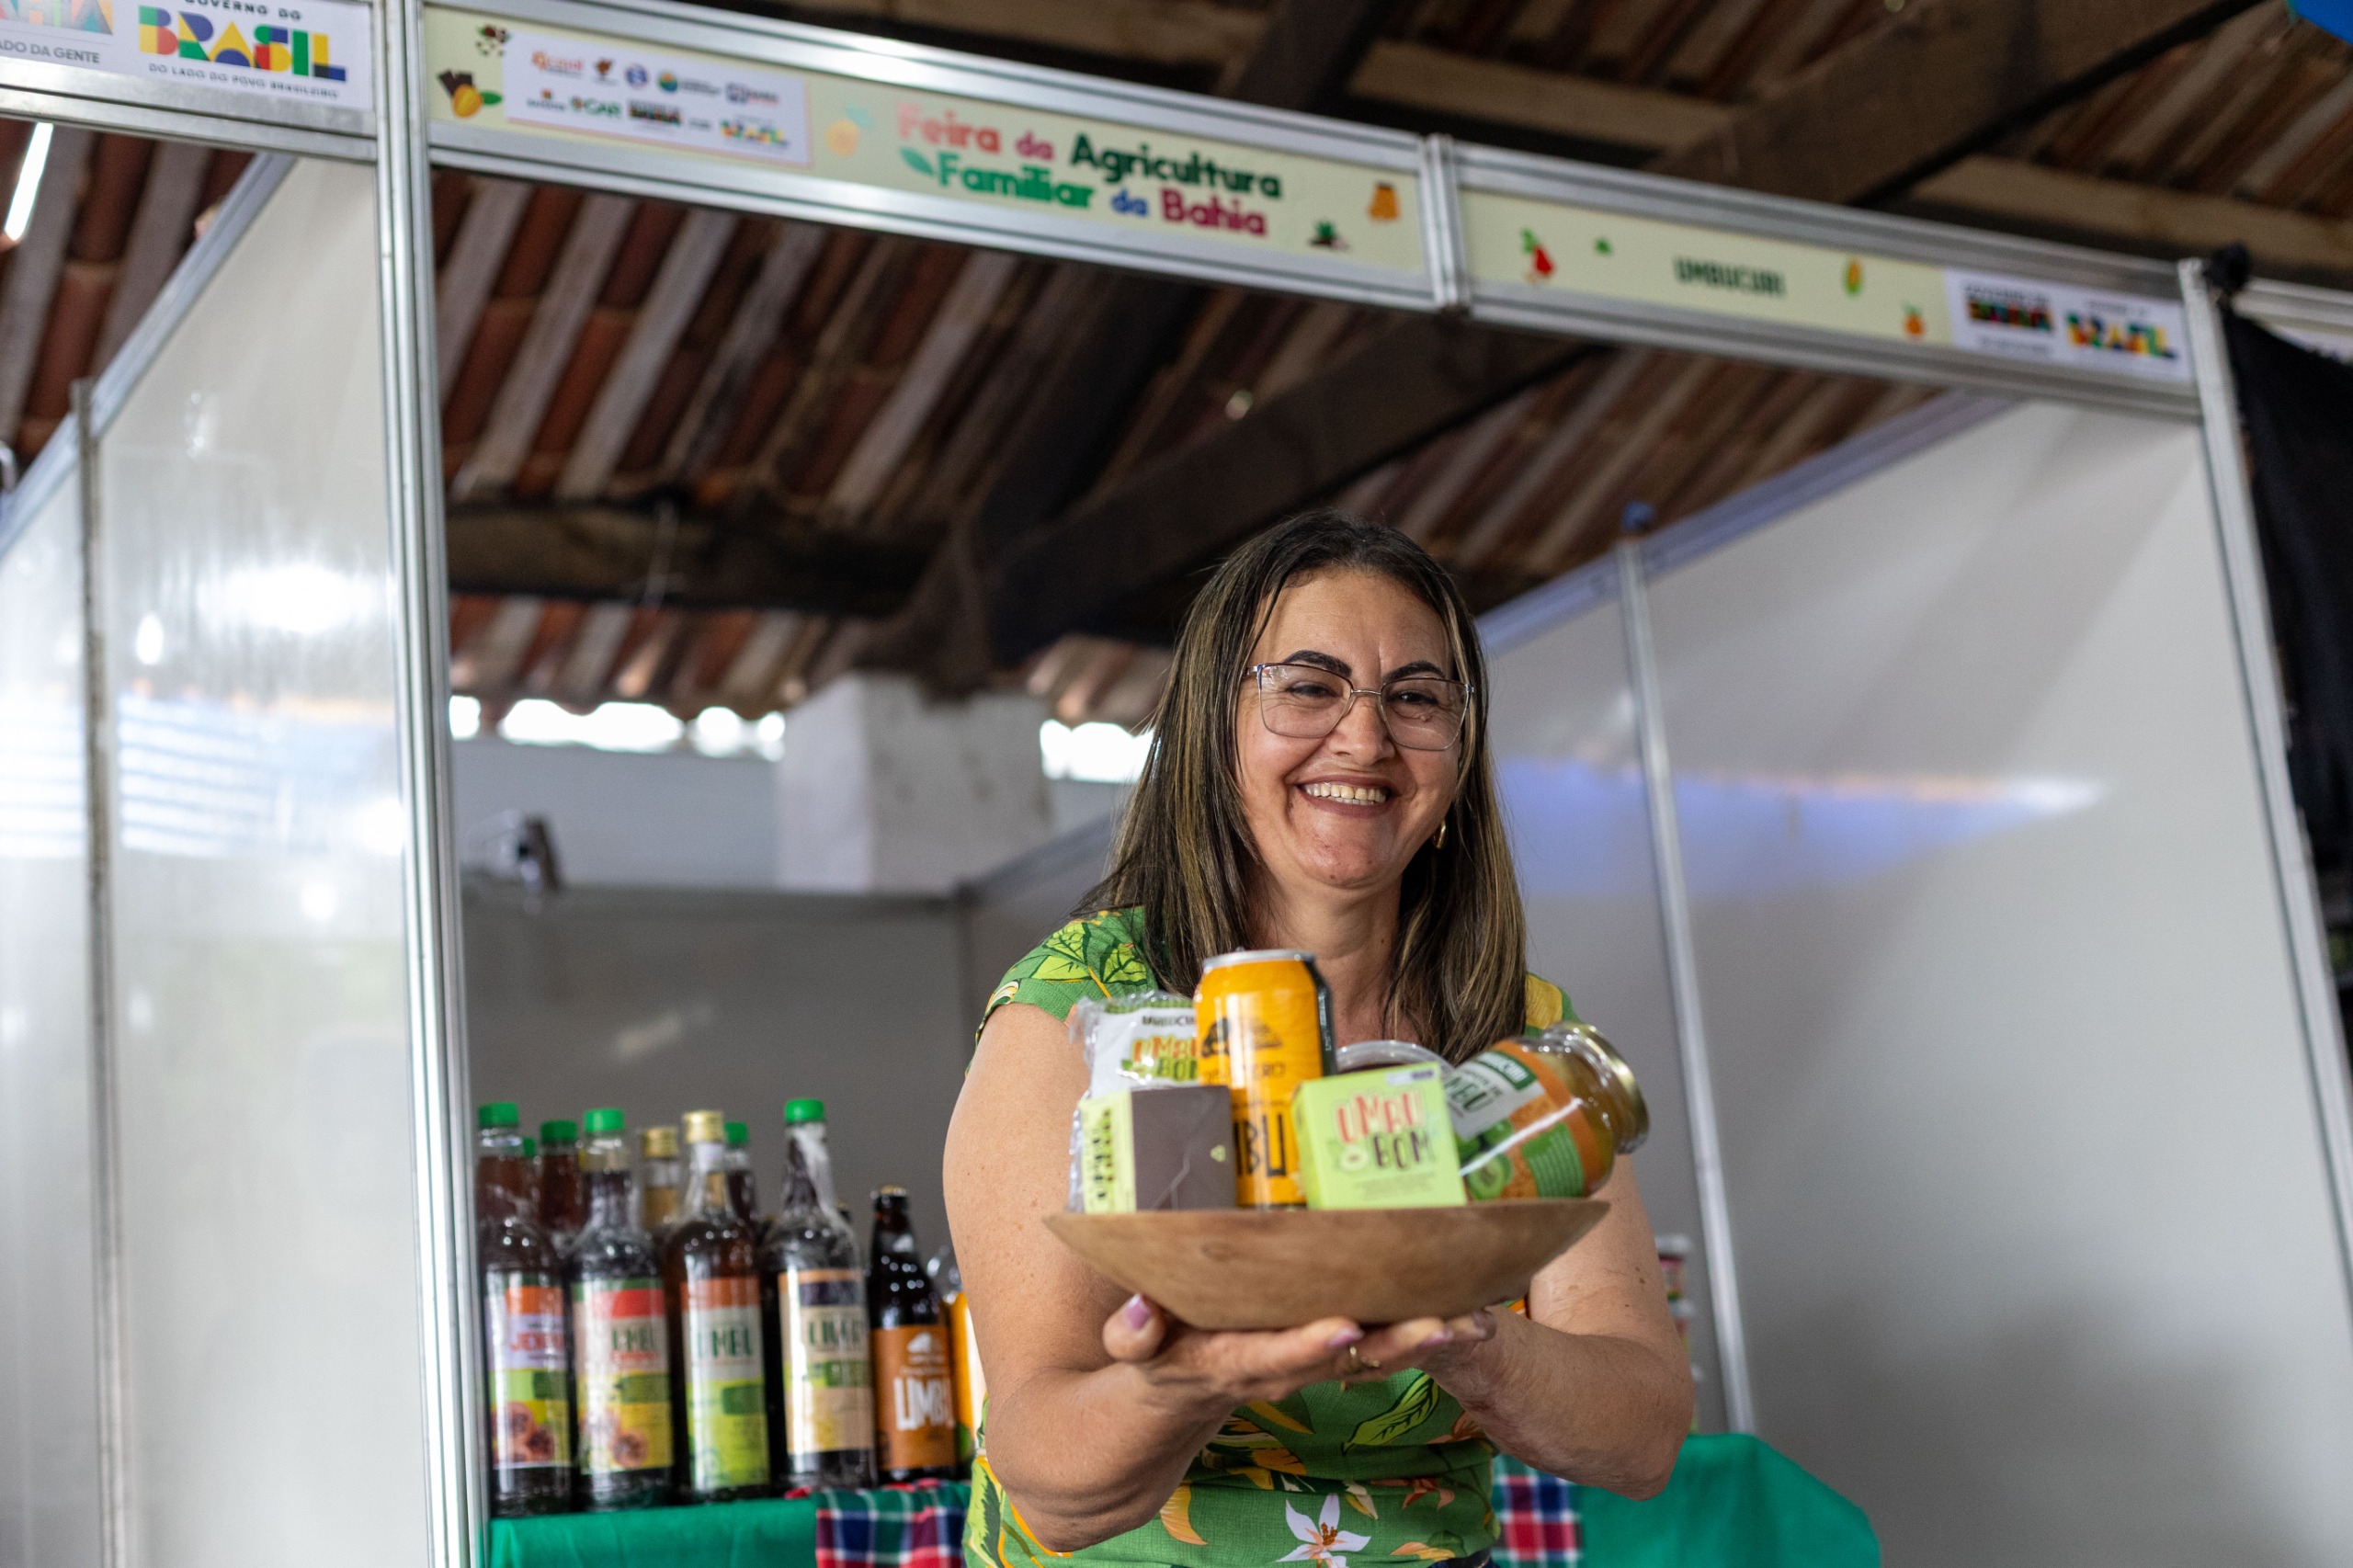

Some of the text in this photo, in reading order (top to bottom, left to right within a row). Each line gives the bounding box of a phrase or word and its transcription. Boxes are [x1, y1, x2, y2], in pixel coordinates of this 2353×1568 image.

[278, 7, 301, 21] DO
[29, 43, 51, 57] DA
[53, 47, 100, 64] GENTE
[138, 5, 347, 84] BRASIL
[148, 62, 168, 74] DO
[172, 64, 206, 79] LADO
[232, 74, 266, 88] POVO
[897, 102, 1283, 199] Feira da Agricultura
[937, 151, 1267, 237] Familiar da Bahia
[1336, 1088, 1425, 1144] UMBU
[1372, 1130, 1436, 1170] BOM
